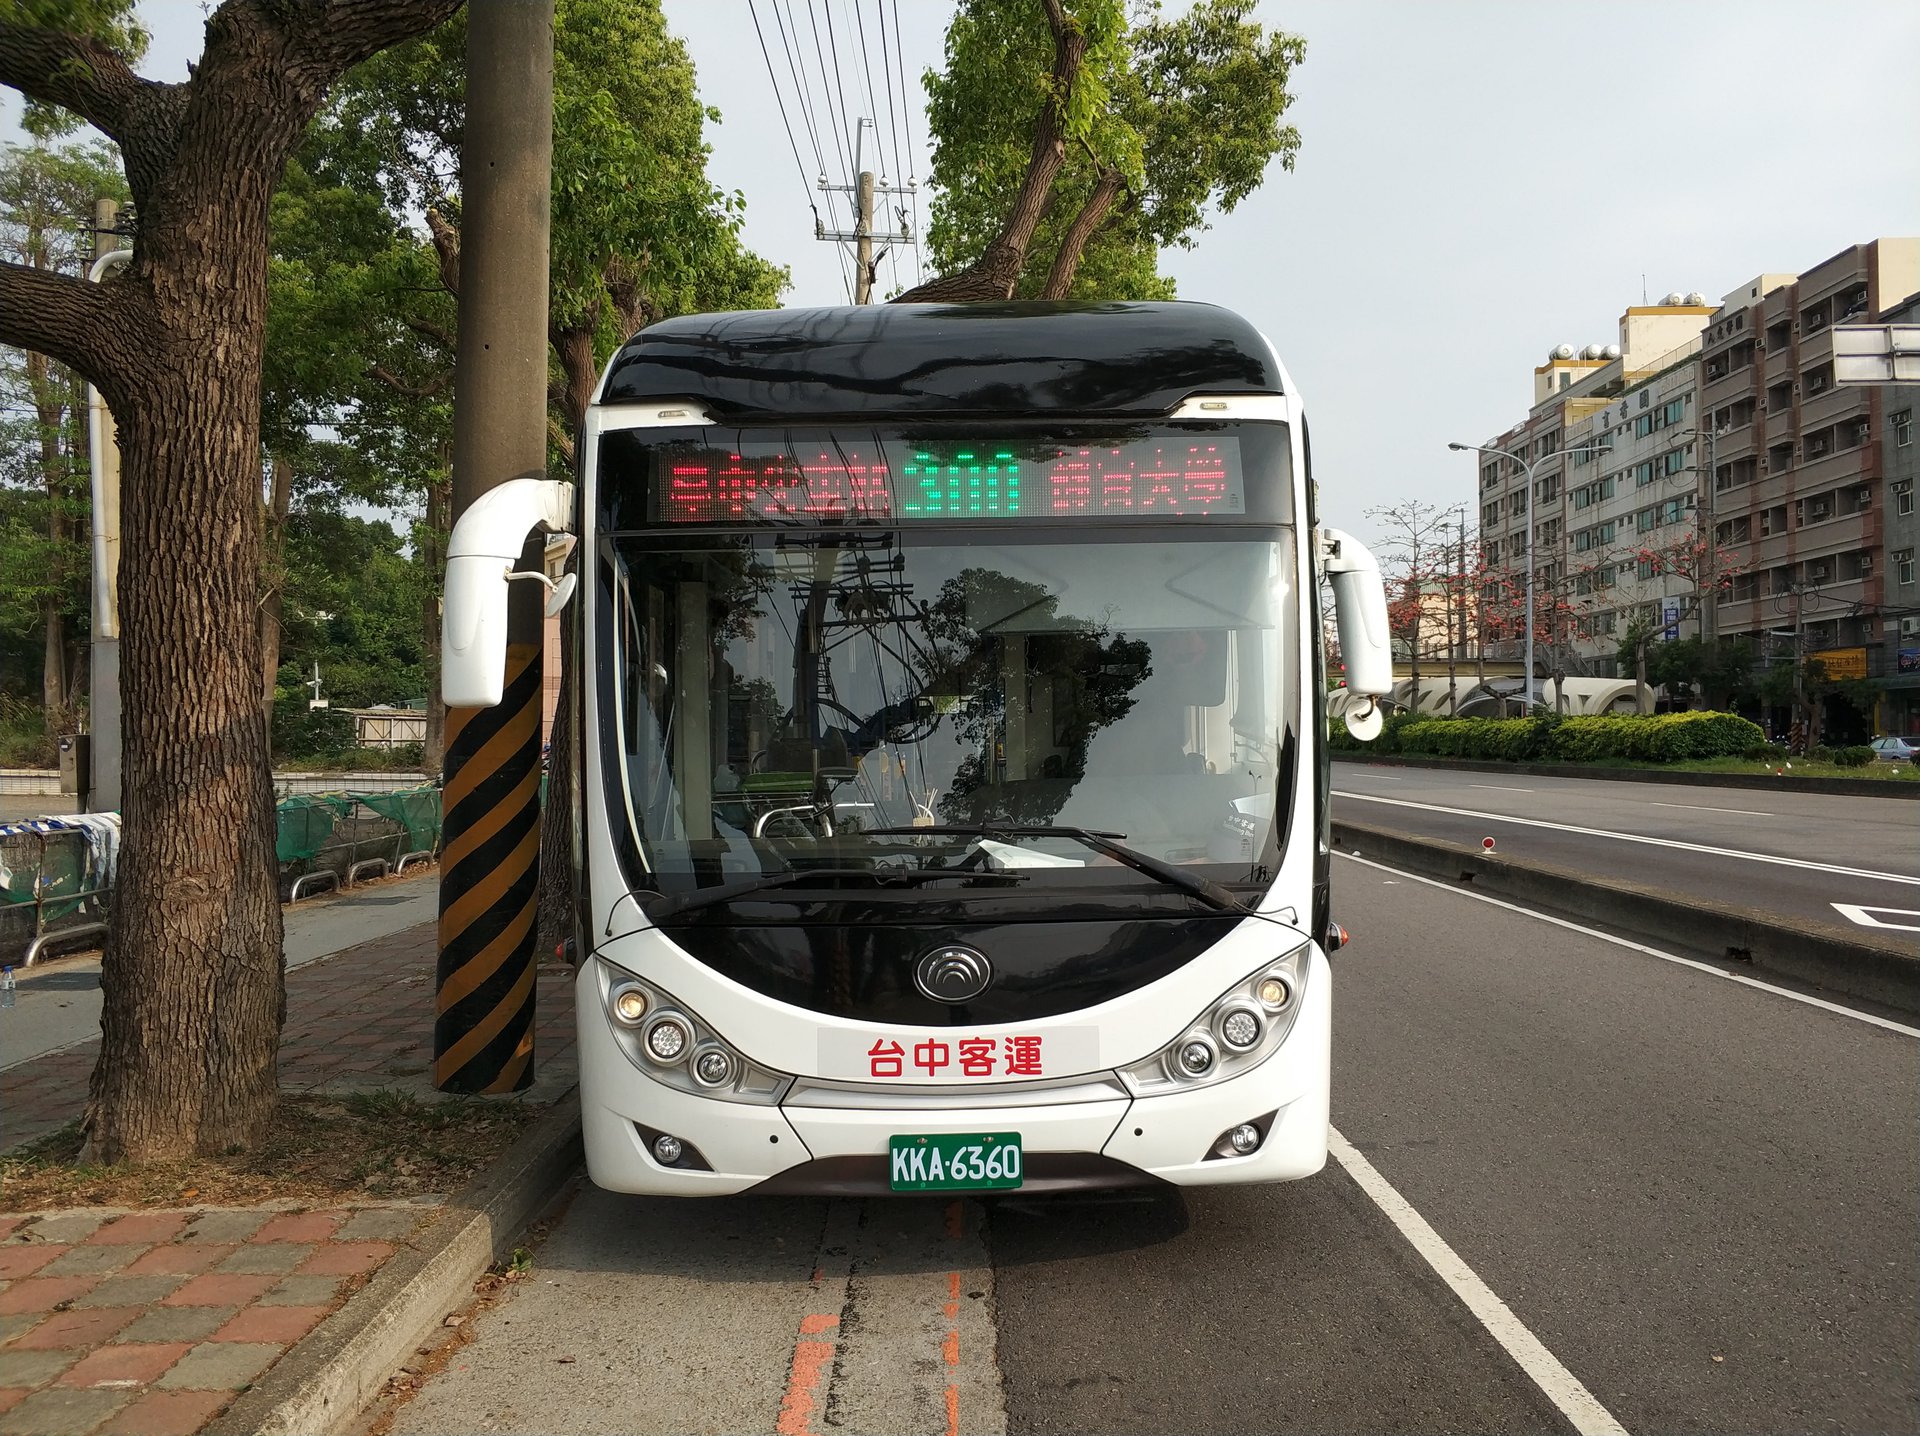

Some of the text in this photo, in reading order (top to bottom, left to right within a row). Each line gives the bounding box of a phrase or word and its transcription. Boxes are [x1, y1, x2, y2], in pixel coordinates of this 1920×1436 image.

[904, 453, 1019, 511] 300
[867, 1036, 1043, 1077] 台中客運
